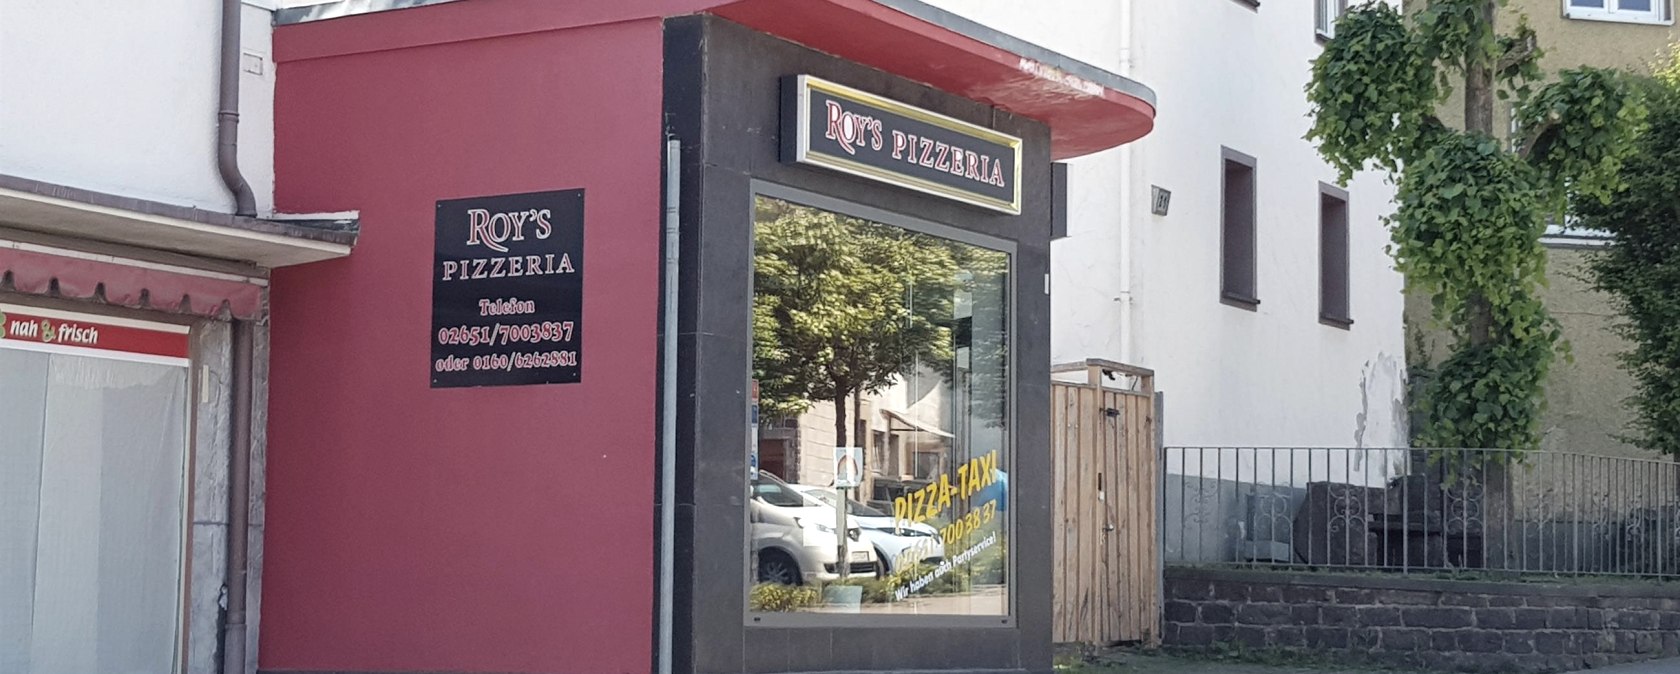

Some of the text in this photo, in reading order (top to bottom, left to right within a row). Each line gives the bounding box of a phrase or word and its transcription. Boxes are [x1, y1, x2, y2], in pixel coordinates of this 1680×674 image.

[892, 130, 1005, 188] PIZZERIA
[442, 252, 575, 281] PIZZERIA
[479, 297, 535, 316] Telefon
[10, 319, 38, 338] nah
[57, 323, 99, 344] frisch
[438, 321, 574, 346] 02651/7003837
[435, 355, 469, 372] oder
[895, 585, 909, 602] Wir
[909, 574, 934, 593] haben
[952, 530, 996, 568] Partyservice!
